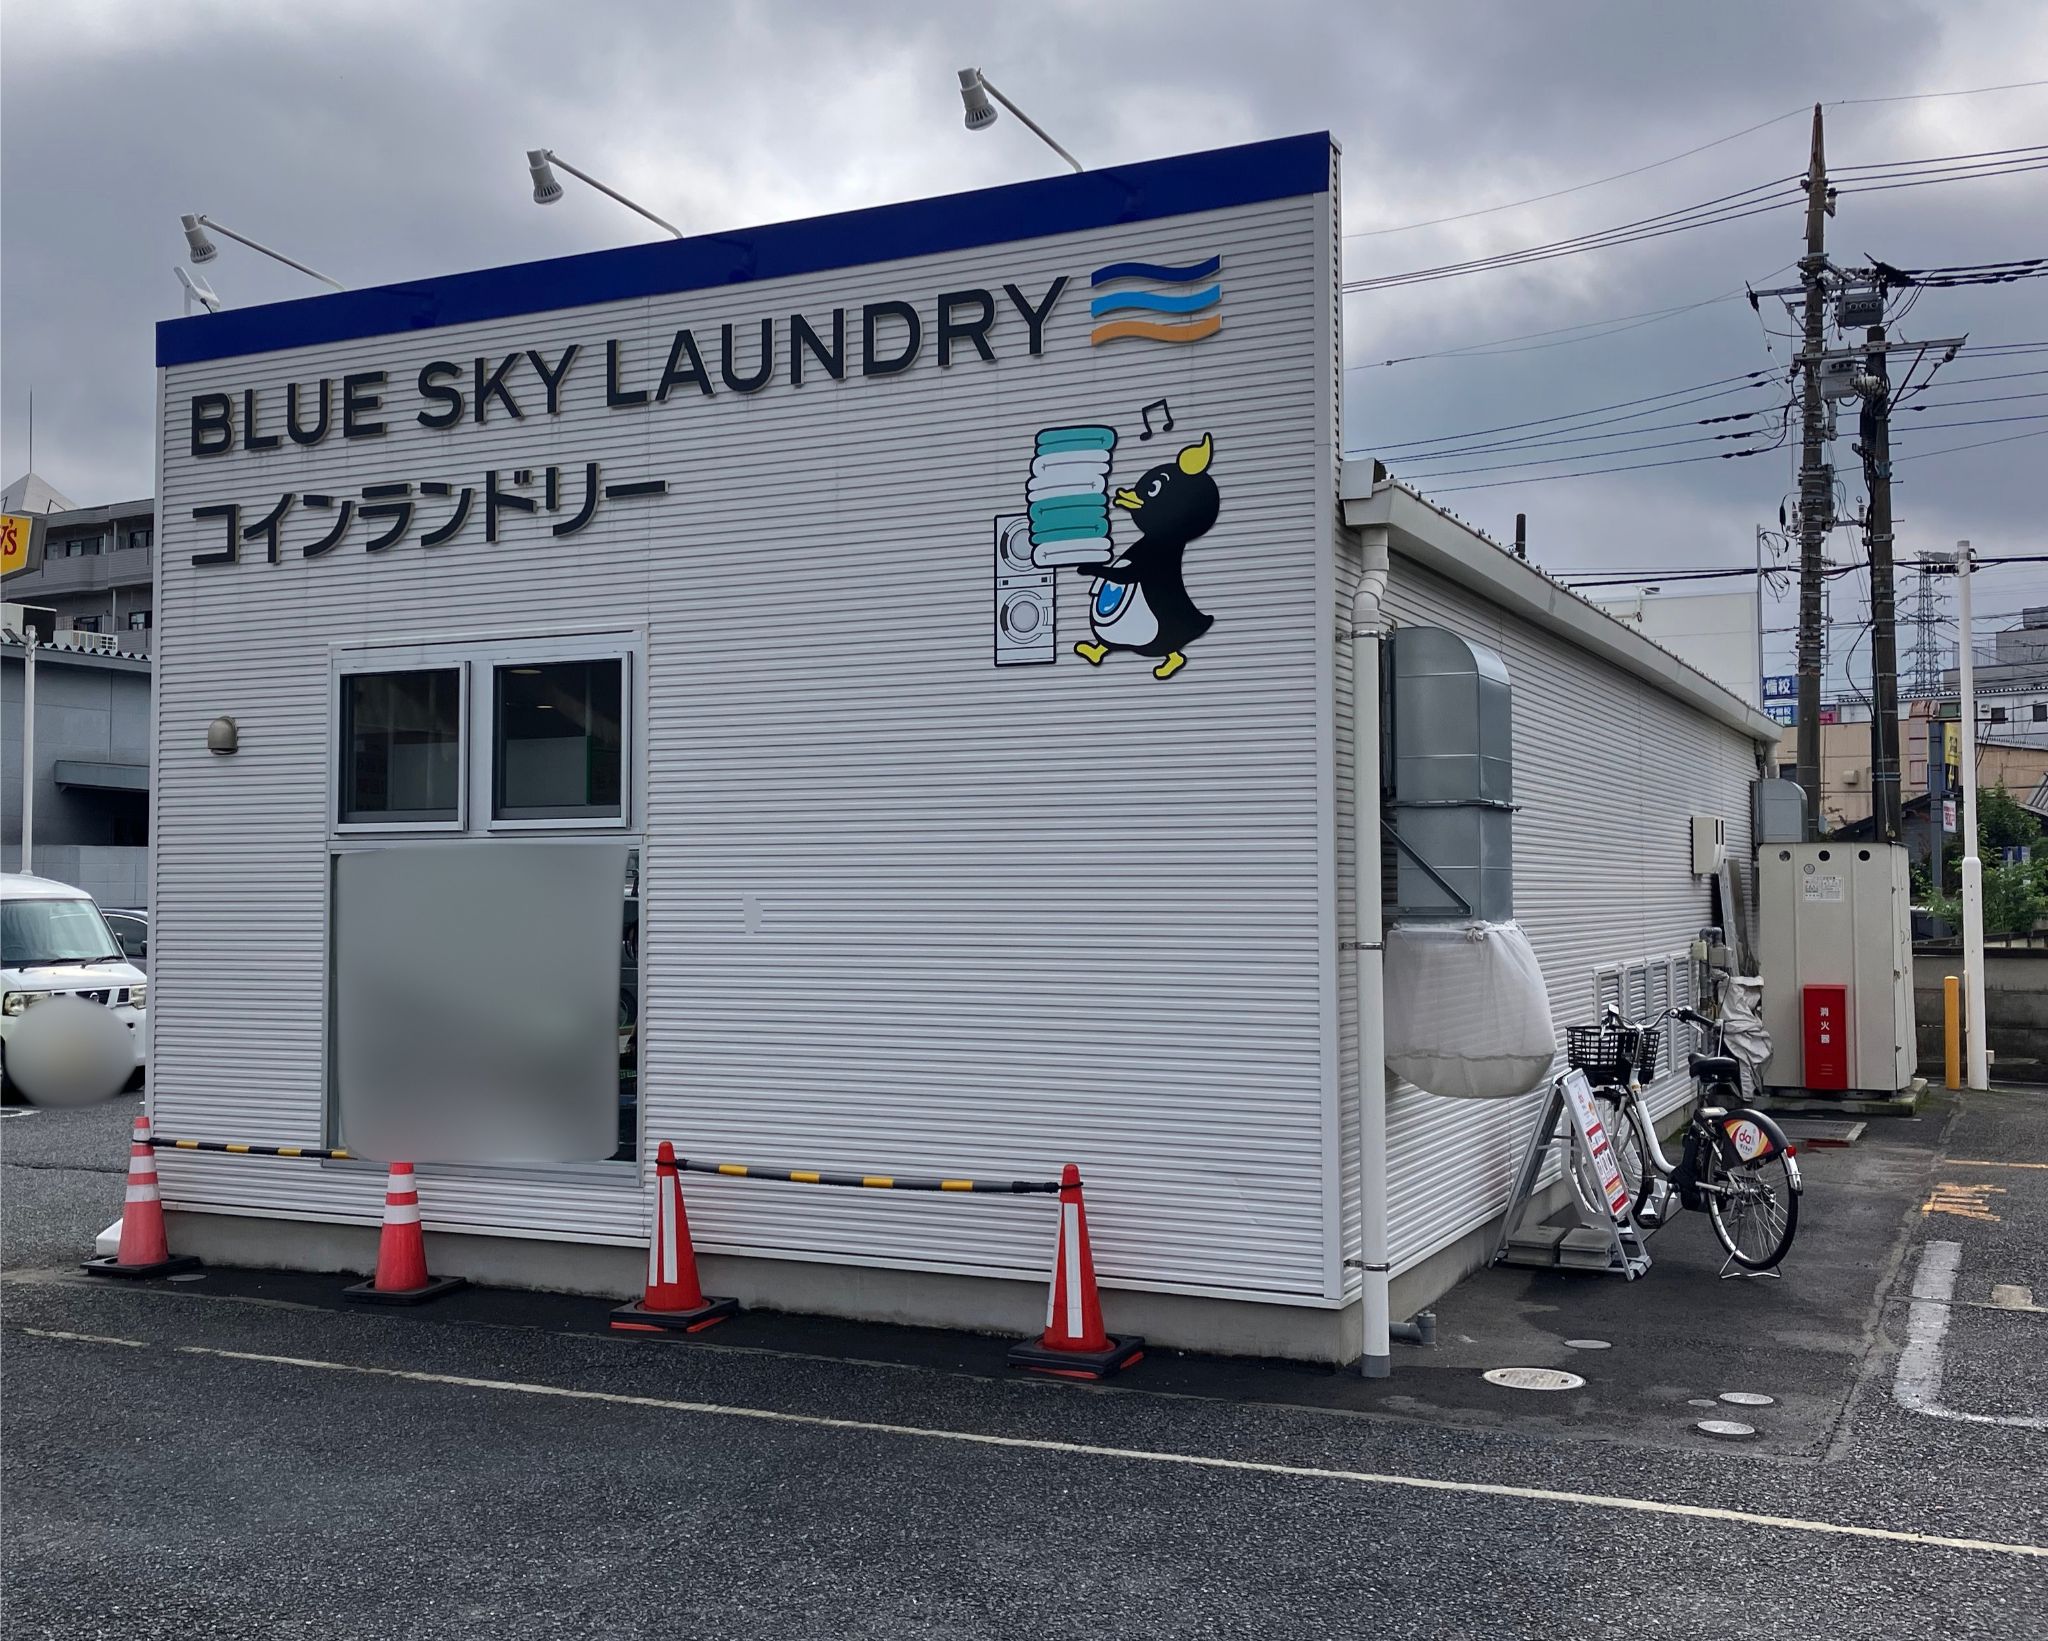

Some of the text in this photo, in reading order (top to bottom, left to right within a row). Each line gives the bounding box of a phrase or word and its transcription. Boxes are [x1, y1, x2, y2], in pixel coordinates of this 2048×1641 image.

[191, 276, 1070, 456] BLUE SKY LAUNDRY
[191, 462, 668, 566] コインランドリー
[1820, 1007, 1830, 1044] 消火器
